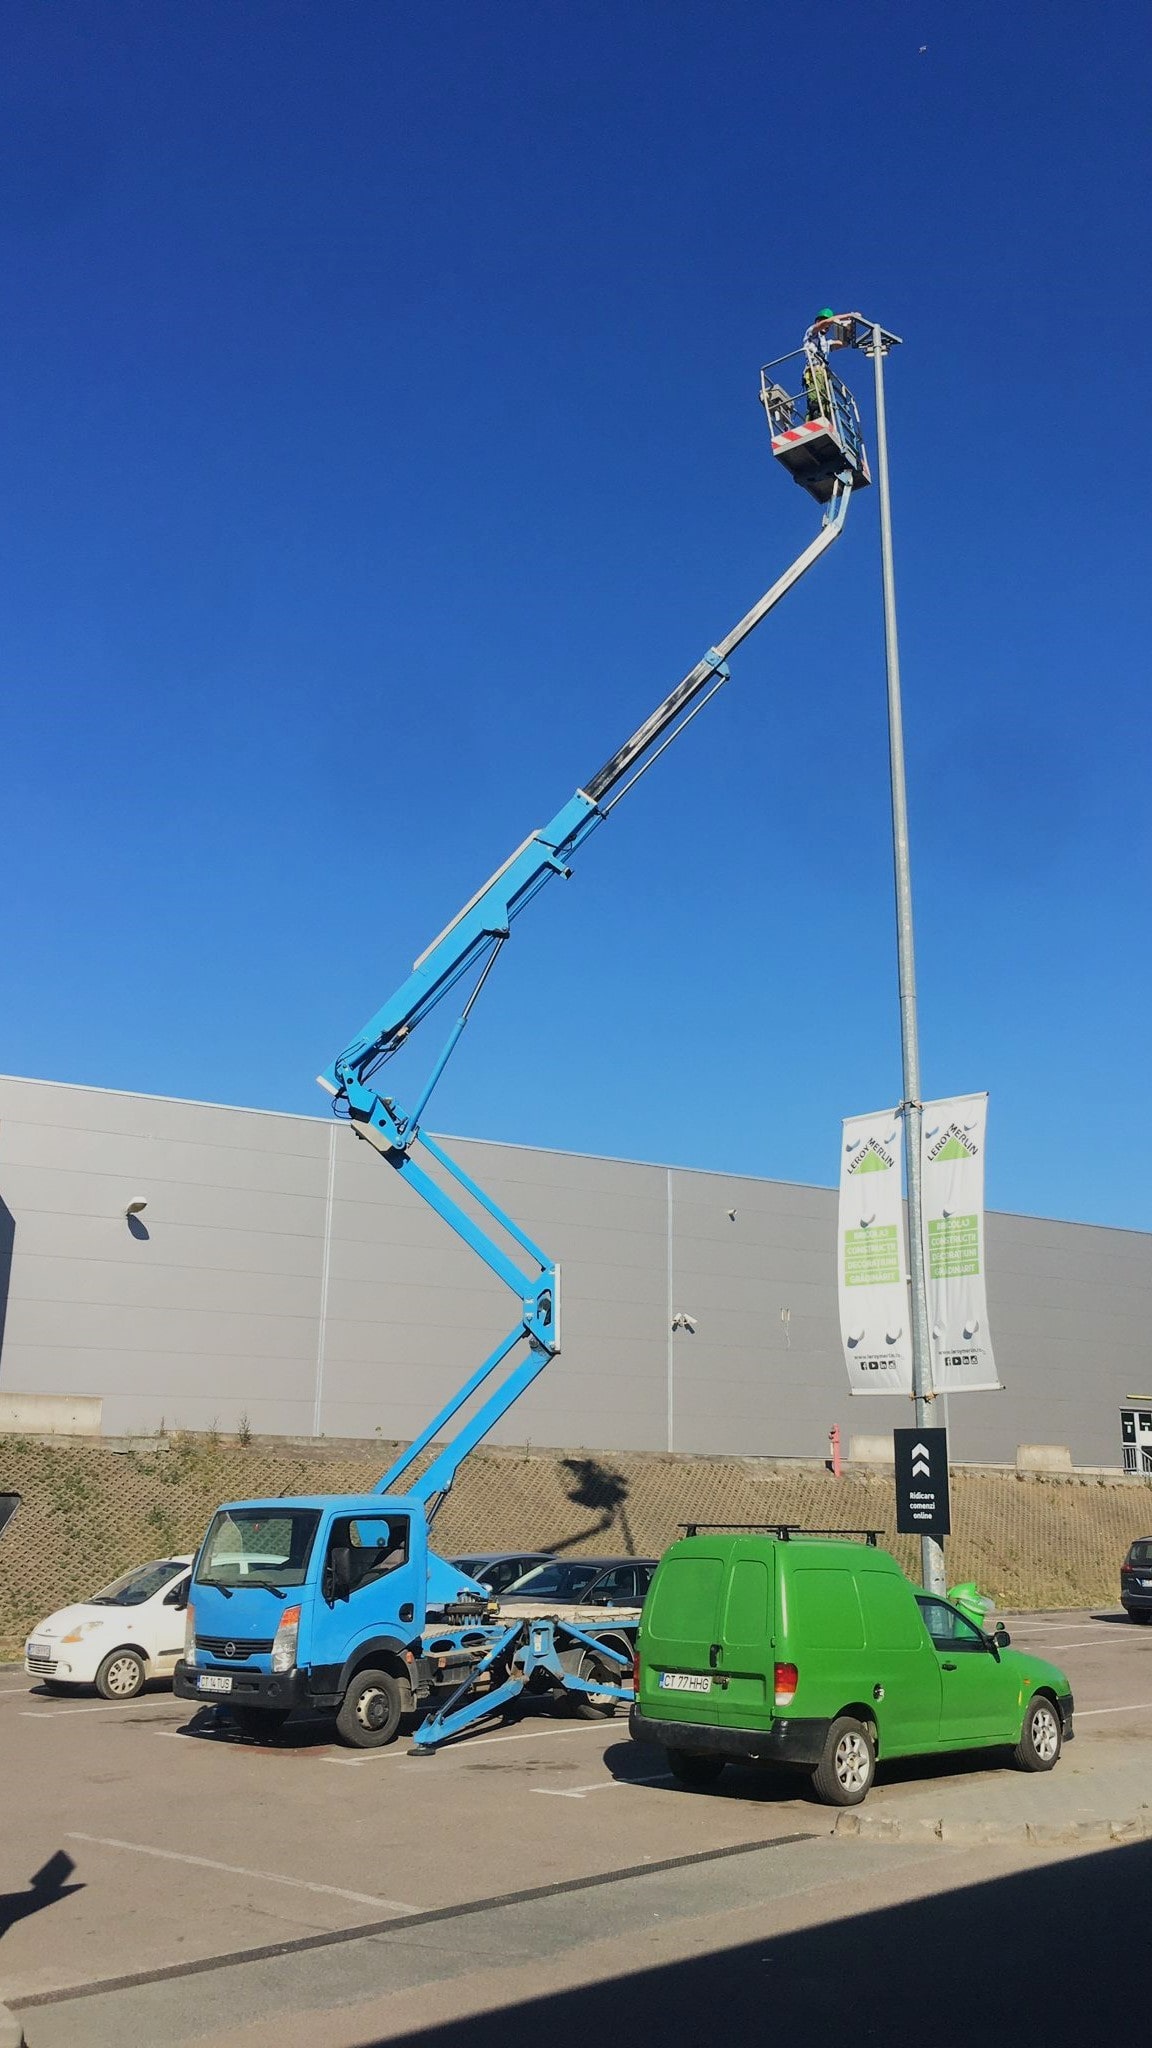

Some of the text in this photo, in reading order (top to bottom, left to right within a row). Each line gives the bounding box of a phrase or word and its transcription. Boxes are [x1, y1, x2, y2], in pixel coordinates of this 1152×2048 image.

[927, 1123, 978, 1161] LEROY MERLIN
[847, 1137, 895, 1175] LEROY MERLIN
[909, 1492, 934, 1500] Ridicare
[909, 1502, 936, 1510] comenzi
[913, 1512, 933, 1520] online
[201, 1676, 209, 1687] CT
[217, 1678, 230, 1689] TUS
[664, 1674, 709, 1690] CT 77 HHG
